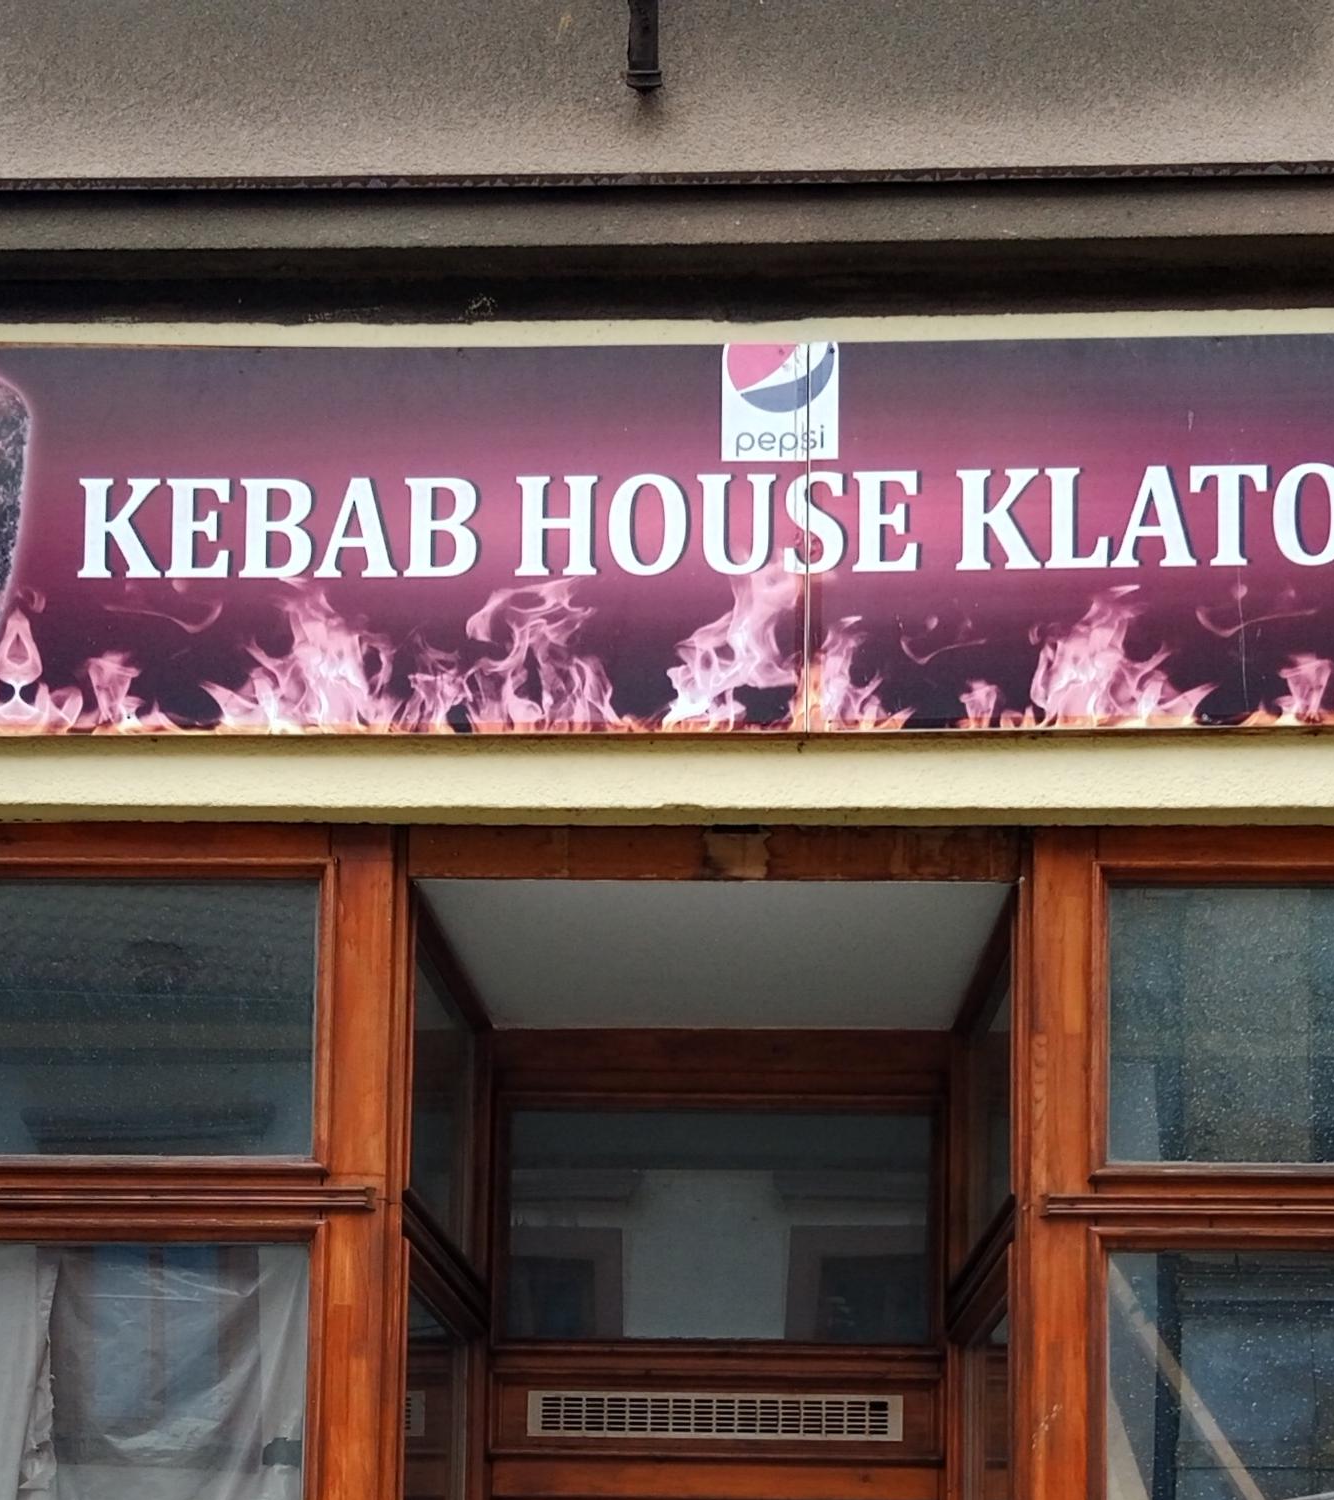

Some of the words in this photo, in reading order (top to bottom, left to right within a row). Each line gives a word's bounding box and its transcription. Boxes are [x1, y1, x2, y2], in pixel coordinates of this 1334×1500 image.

[735, 424, 825, 458] pepsi
[78, 475, 478, 580] KEBAB
[515, 469, 920, 577] HOUSE
